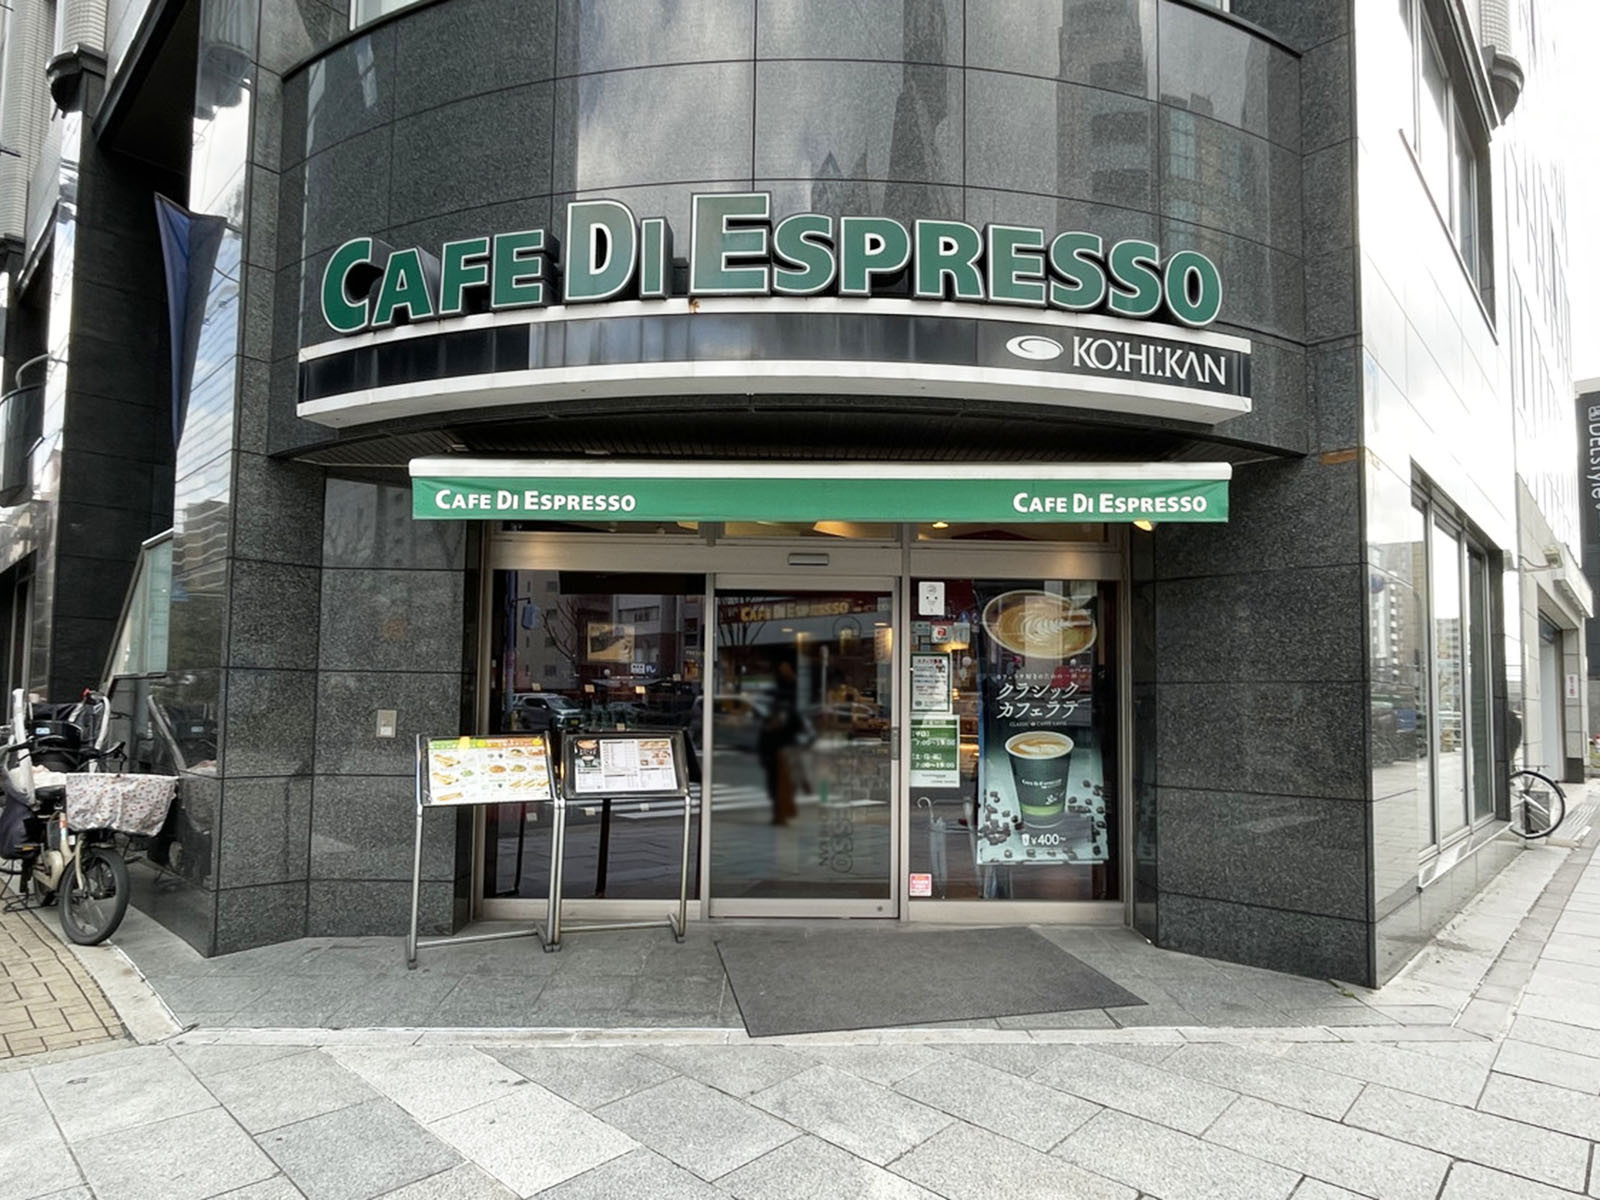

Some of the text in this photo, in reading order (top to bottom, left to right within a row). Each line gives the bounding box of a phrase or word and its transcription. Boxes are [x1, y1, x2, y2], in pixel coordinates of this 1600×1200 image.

[321, 191, 1223, 334] CAFE DI ESPRESSO
[435, 489, 636, 511] CAFE DI ESPRESSO
[1013, 492, 1207, 513] CAFE DI ESPRESSO
[996, 681, 1079, 700] クラシック
[996, 701, 1079, 719] カフェラテ
